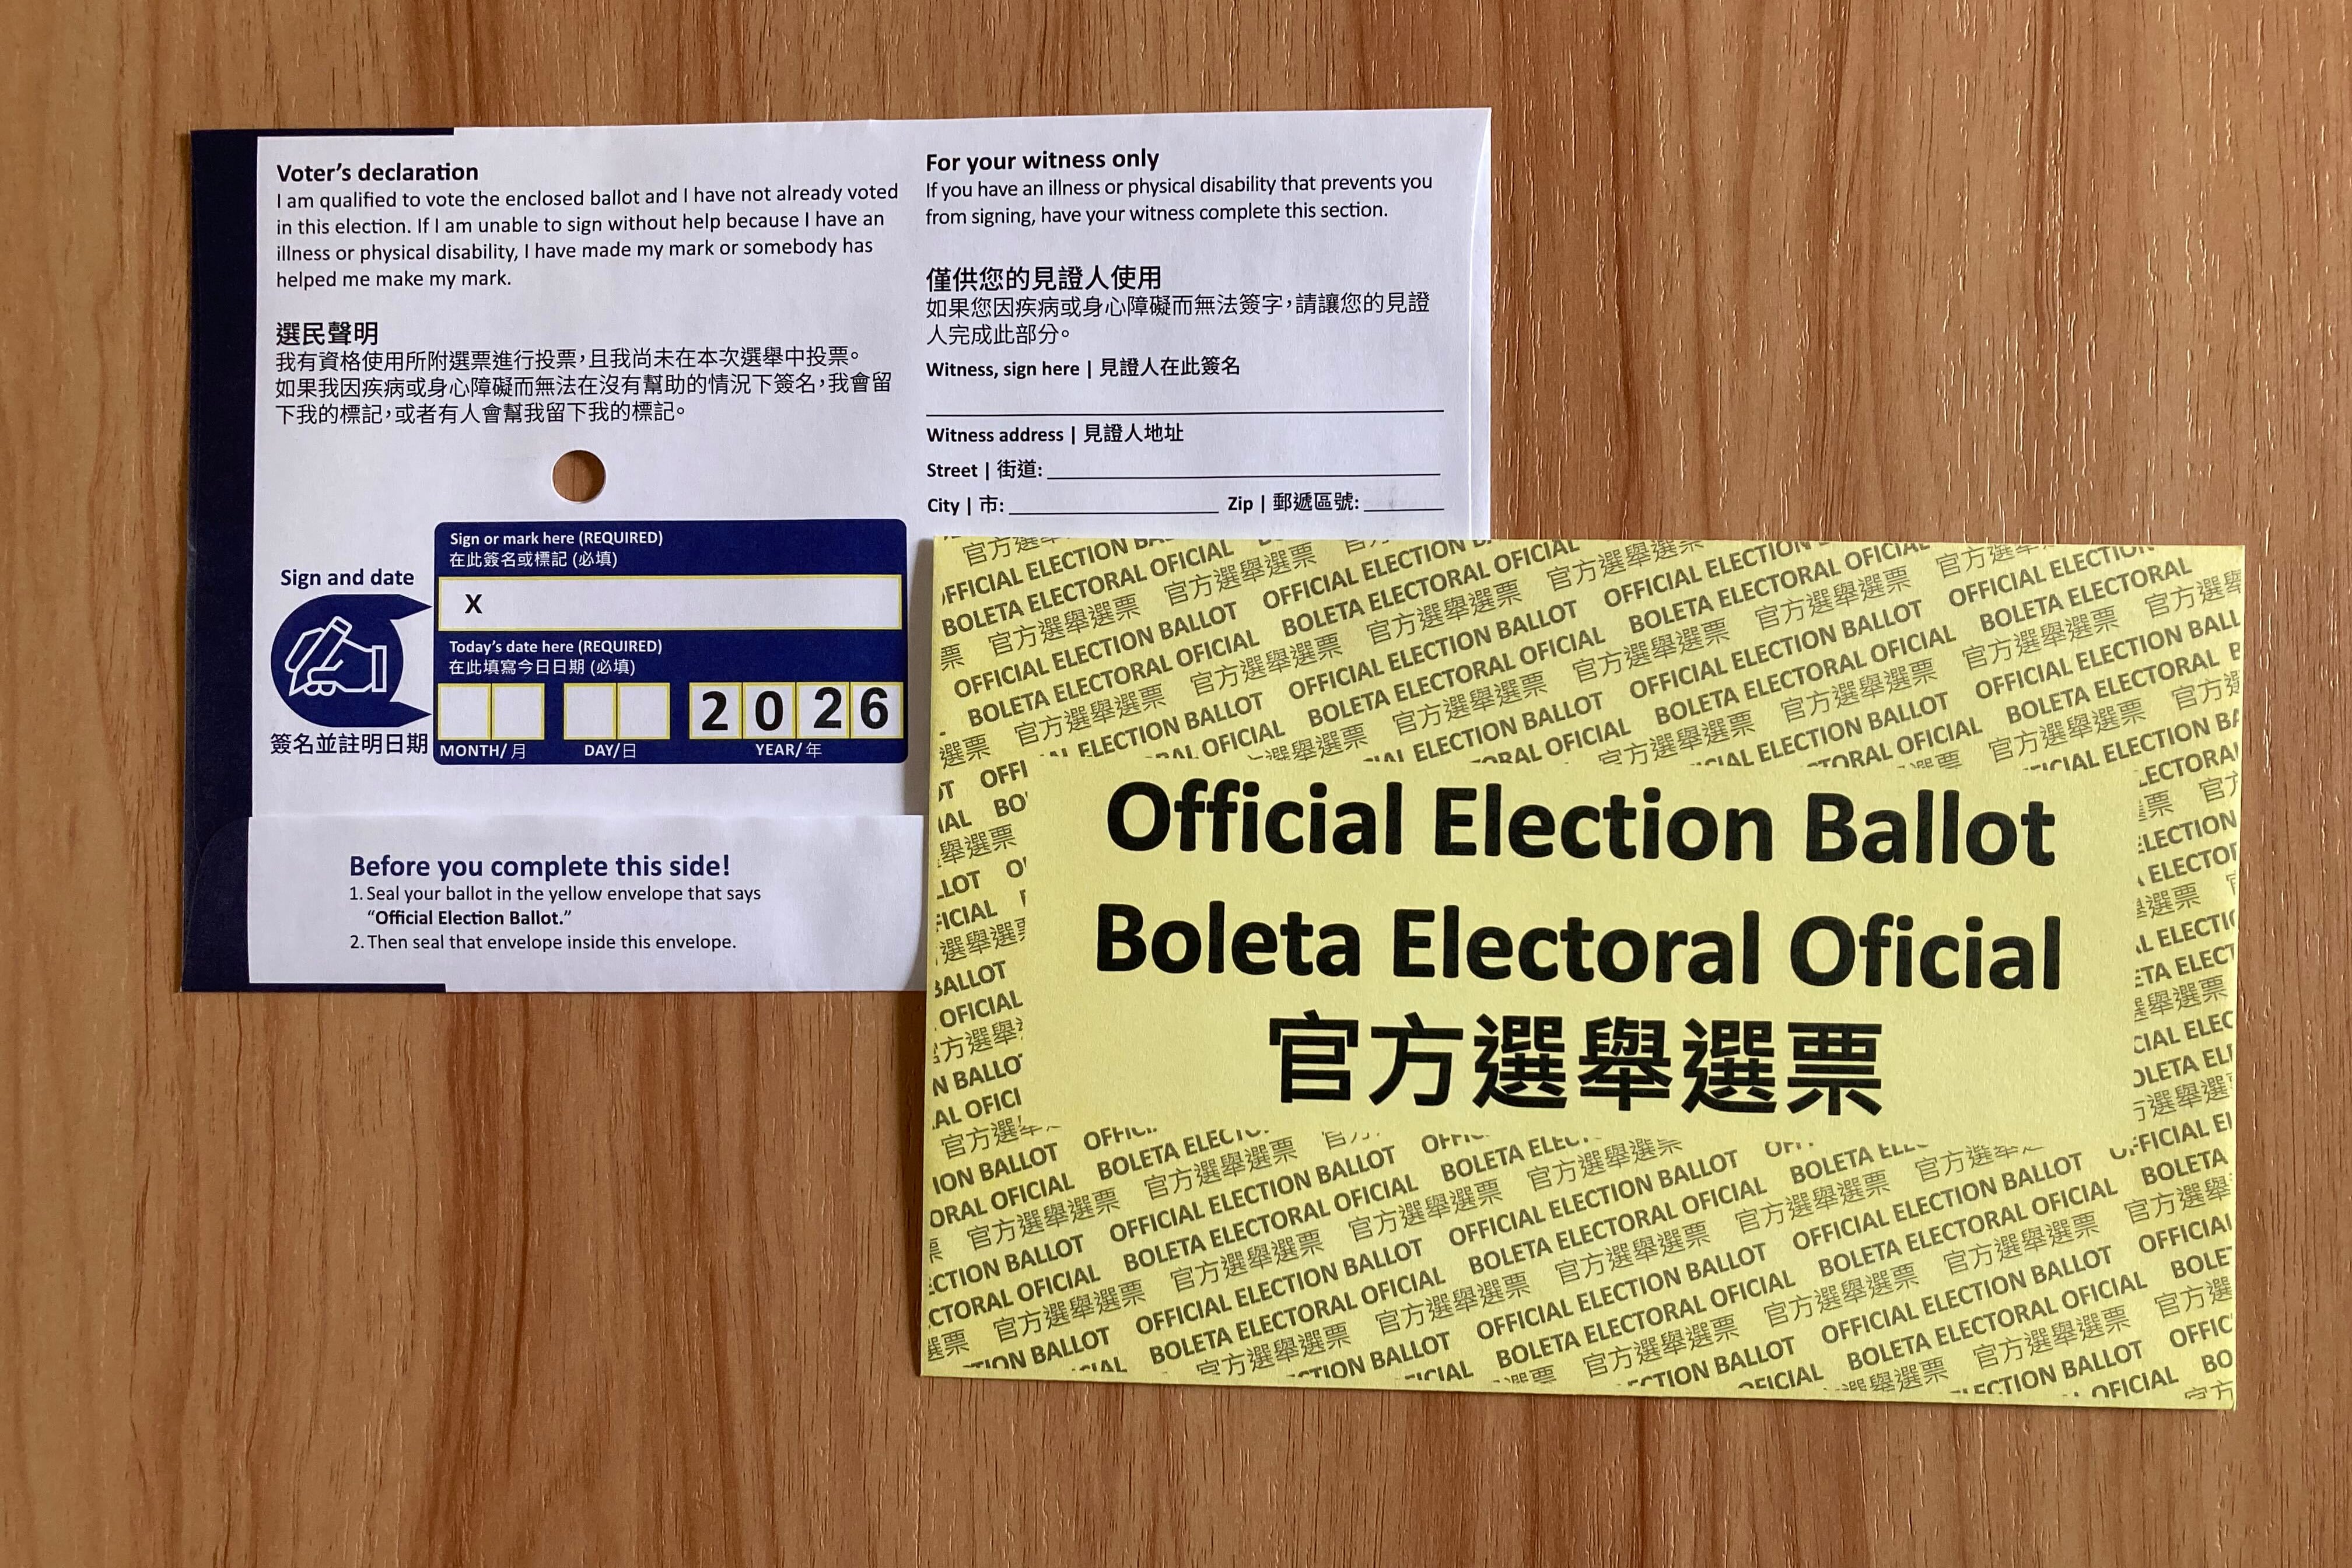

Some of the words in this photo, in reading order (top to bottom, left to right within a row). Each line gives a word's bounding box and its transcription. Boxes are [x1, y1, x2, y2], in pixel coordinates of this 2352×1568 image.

[358, 162, 478, 181] declaration
[926, 153, 961, 172] For
[966, 156, 1017, 176] your
[1022, 150, 1106, 170] witness
[1112, 148, 1160, 172] only
[277, 193, 281, 209] I
[287, 196, 314, 209] am
[320, 191, 397, 212] qualified
[401, 192, 421, 208] to
[425, 192, 465, 207] vote
[470, 190, 500, 207] the
[505, 190, 584, 206] enclosed
[590, 188, 640, 206] ballot
[645, 187, 677, 204] and
[684, 187, 688, 203] I
[694, 186, 736, 203] have
[741, 187, 771, 202] not
[776, 183, 843, 204] already
[847, 182, 898, 200] voted
[926, 181, 939, 198] If
[941, 185, 972, 202] you
[978, 180, 1018, 197] have
[1023, 184, 1044, 197] an
[1049, 178, 1100, 196] illness
[1104, 182, 1124, 195] or
[1128, 176, 1195, 198] physical
[1200, 174, 1276, 195] disability
[1280, 174, 1316, 191] that
[1321, 174, 1396, 195] prevents
[1400, 176, 1432, 193] you
[276, 244, 331, 261] illness
[335, 249, 355, 261] or
[360, 243, 430, 264] physical
[436, 243, 519, 263] disability,
[525, 243, 528, 259] I
[535, 242, 576, 259] have
[582, 241, 631, 258] made
[637, 244, 664, 260] my
[669, 239, 715, 256] mark
[719, 243, 739, 256] or
[744, 236, 838, 258] somebody
[843, 236, 873, 254] has
[276, 270, 337, 291] helped
[342, 275, 370, 287] me
[376, 270, 424, 286] make
[430, 274, 456, 290] my
[461, 269, 511, 286] mark.
[926, 264, 1161, 293] 僅供您的見證人使用
[275, 321, 378, 346] 選民聲明
[926, 323, 1069, 345] 人完成此部分。
[926, 362, 999, 380] Witness,
[1003, 361, 1037, 380] sign
[1042, 360, 1080, 376] here
[1099, 355, 1240, 377] 見證人在此簽名
[926, 427, 995, 443] Witness
[999, 426, 1064, 443] address
[1083, 422, 1184, 443] 見證人地址
[926, 463, 978, 478] Street
[996, 459, 1042, 480] 街道:
[928, 498, 960, 516] City
[978, 494, 1004, 514] 市:
[1227, 495, 1254, 514] Zip
[1273, 491, 1359, 512] 郵遞區號:
[450, 532, 480, 548] Sign
[484, 536, 499, 545] or
[503, 531, 539, 545] mark
[543, 531, 575, 544] here
[579, 530, 663, 547] (REQUIRED)
[449, 551, 567, 568] 在此簽名或標記
[281, 568, 321, 590] Sign
[327, 568, 364, 586] and
[370, 568, 414, 586] date
[942, 599, 1025, 637] BOLETA
[1026, 564, 1148, 613] ELECTORAL
[1149, 538, 1235, 578] OFICIAL
[464, 593, 483, 614] X
[1979, 593, 2065, 632] BOLETA
[2067, 558, 2193, 607] ELECTORAL
[506, 640, 538, 653] date
[542, 640, 574, 653] here
[578, 639, 662, 655] (REQUIRED)
[954, 657, 1051, 698] OFFICIAL
[1051, 626, 1155, 671] ELECTION
[1158, 601, 1237, 640] BALLOT
[1629, 657, 1729, 699] OFFICIAL
[1731, 624, 1838, 671] ELECTION
[1840, 598, 1922, 639] BALLOT
[270, 732, 428, 755] 簽名並註明日期
[1108, 779, 1402, 855] Official
[1435, 783, 1772, 861] Election
[1807, 790, 2054, 866] Ballot
[350, 854, 430, 877] Before
[437, 860, 483, 882] you
[491, 854, 608, 882] complete
[615, 854, 662, 877] this
[670, 854, 729, 877] side!
[366, 885, 399, 901] Seal
[404, 890, 442, 904] your
[446, 885, 492, 901] ballot
[497, 886, 512, 901] in
[516, 885, 544, 901] the
[548, 885, 603, 904] yellow
[607, 885, 683, 904] envelope
[687, 885, 722, 901] that
[727, 889, 761, 904] says
[438, 909, 504, 925] Election
[366, 934, 408, 949] Then
[412, 934, 444, 949] seal
[449, 934, 483, 949] that
[487, 934, 562, 953] envelope
[568, 934, 616, 949] inside
[620, 934, 651, 949] this
[656, 933, 736, 953] envelope.
[1097, 901, 1360, 977] Boleta
[1394, 905, 1759, 984] Electoral
[1791, 913, 2060, 989] Oficial
[939, 990, 1024, 1028] OFICIAL
[1270, 1010, 1881, 1115] 官方選舉選票
[1110, 1201, 1206, 1242] OFFICIAL
[1208, 1170, 1312, 1216] ELECTION
[1315, 1144, 1395, 1185] BALLOT
[1793, 1209, 1890, 1251] OFFICIAL
[1892, 1177, 1998, 1223] ELECTION
[2001, 1152, 2082, 1192] BALLOT
[1123, 1234, 1208, 1273] BOLETA
[1209, 1198, 1331, 1248] ELECTORAL
[1334, 1173, 1419, 1212] OFICIAL
[1818, 1238, 1903, 1278] BOLETA
[1905, 1203, 2029, 1252] ELECTORAL
[2031, 1178, 2119, 1216] OFICIAL
